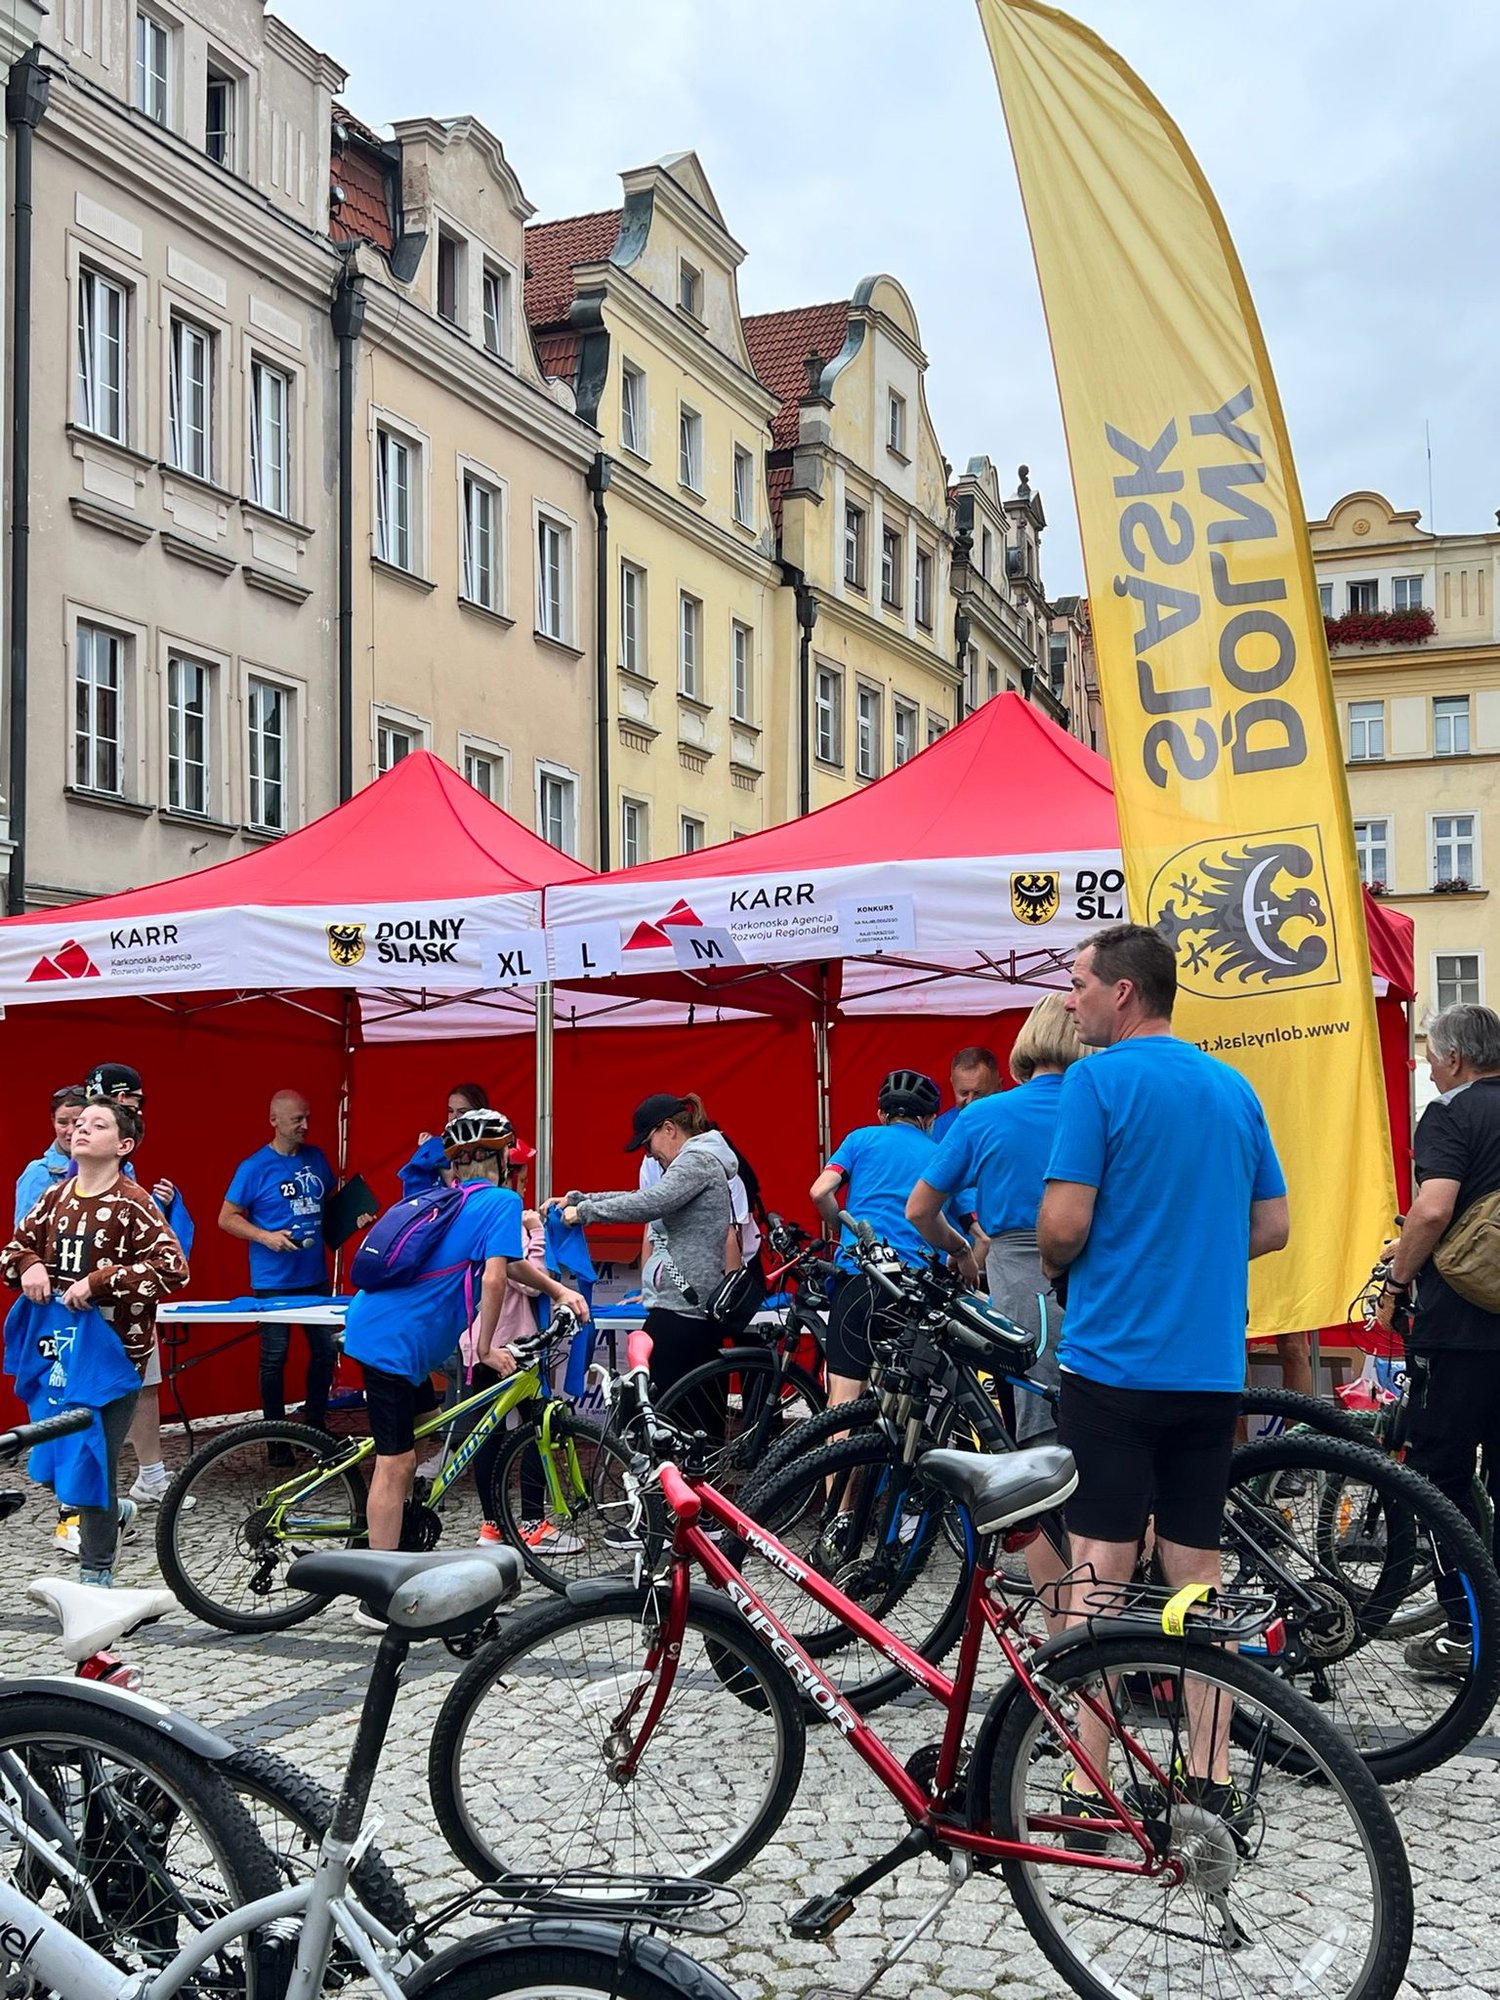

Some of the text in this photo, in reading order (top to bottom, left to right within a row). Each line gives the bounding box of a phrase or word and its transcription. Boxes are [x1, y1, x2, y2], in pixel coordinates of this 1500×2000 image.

[1075, 869, 1125, 893] DO
[730, 883, 815, 912] KARR
[857, 904, 894, 913] KONKURS
[1075, 890, 1123, 920] ŚL
[375, 918, 465, 941] DOLNY
[730, 914, 833, 931] Karkonoska Agencja
[732, 924, 839, 942] Rozwoju Regionalneg
[110, 924, 178, 949] KARR
[690, 938, 724, 960] M
[110, 953, 192, 967] Karkonoska Agencja
[378, 936, 459, 966] ŚLĄSK
[582, 943, 596, 969] L
[110, 962, 202, 977] Rozwoju Regionalnego
[497, 950, 532, 978] XL
[280, 1183, 296, 1197] 23
[60, 1238, 84, 1273] H
[440, 1410, 498, 1486] GHOST
[745, 1529, 808, 1583] MARTLET
[726, 1579, 856, 1736] SUPERIOR
